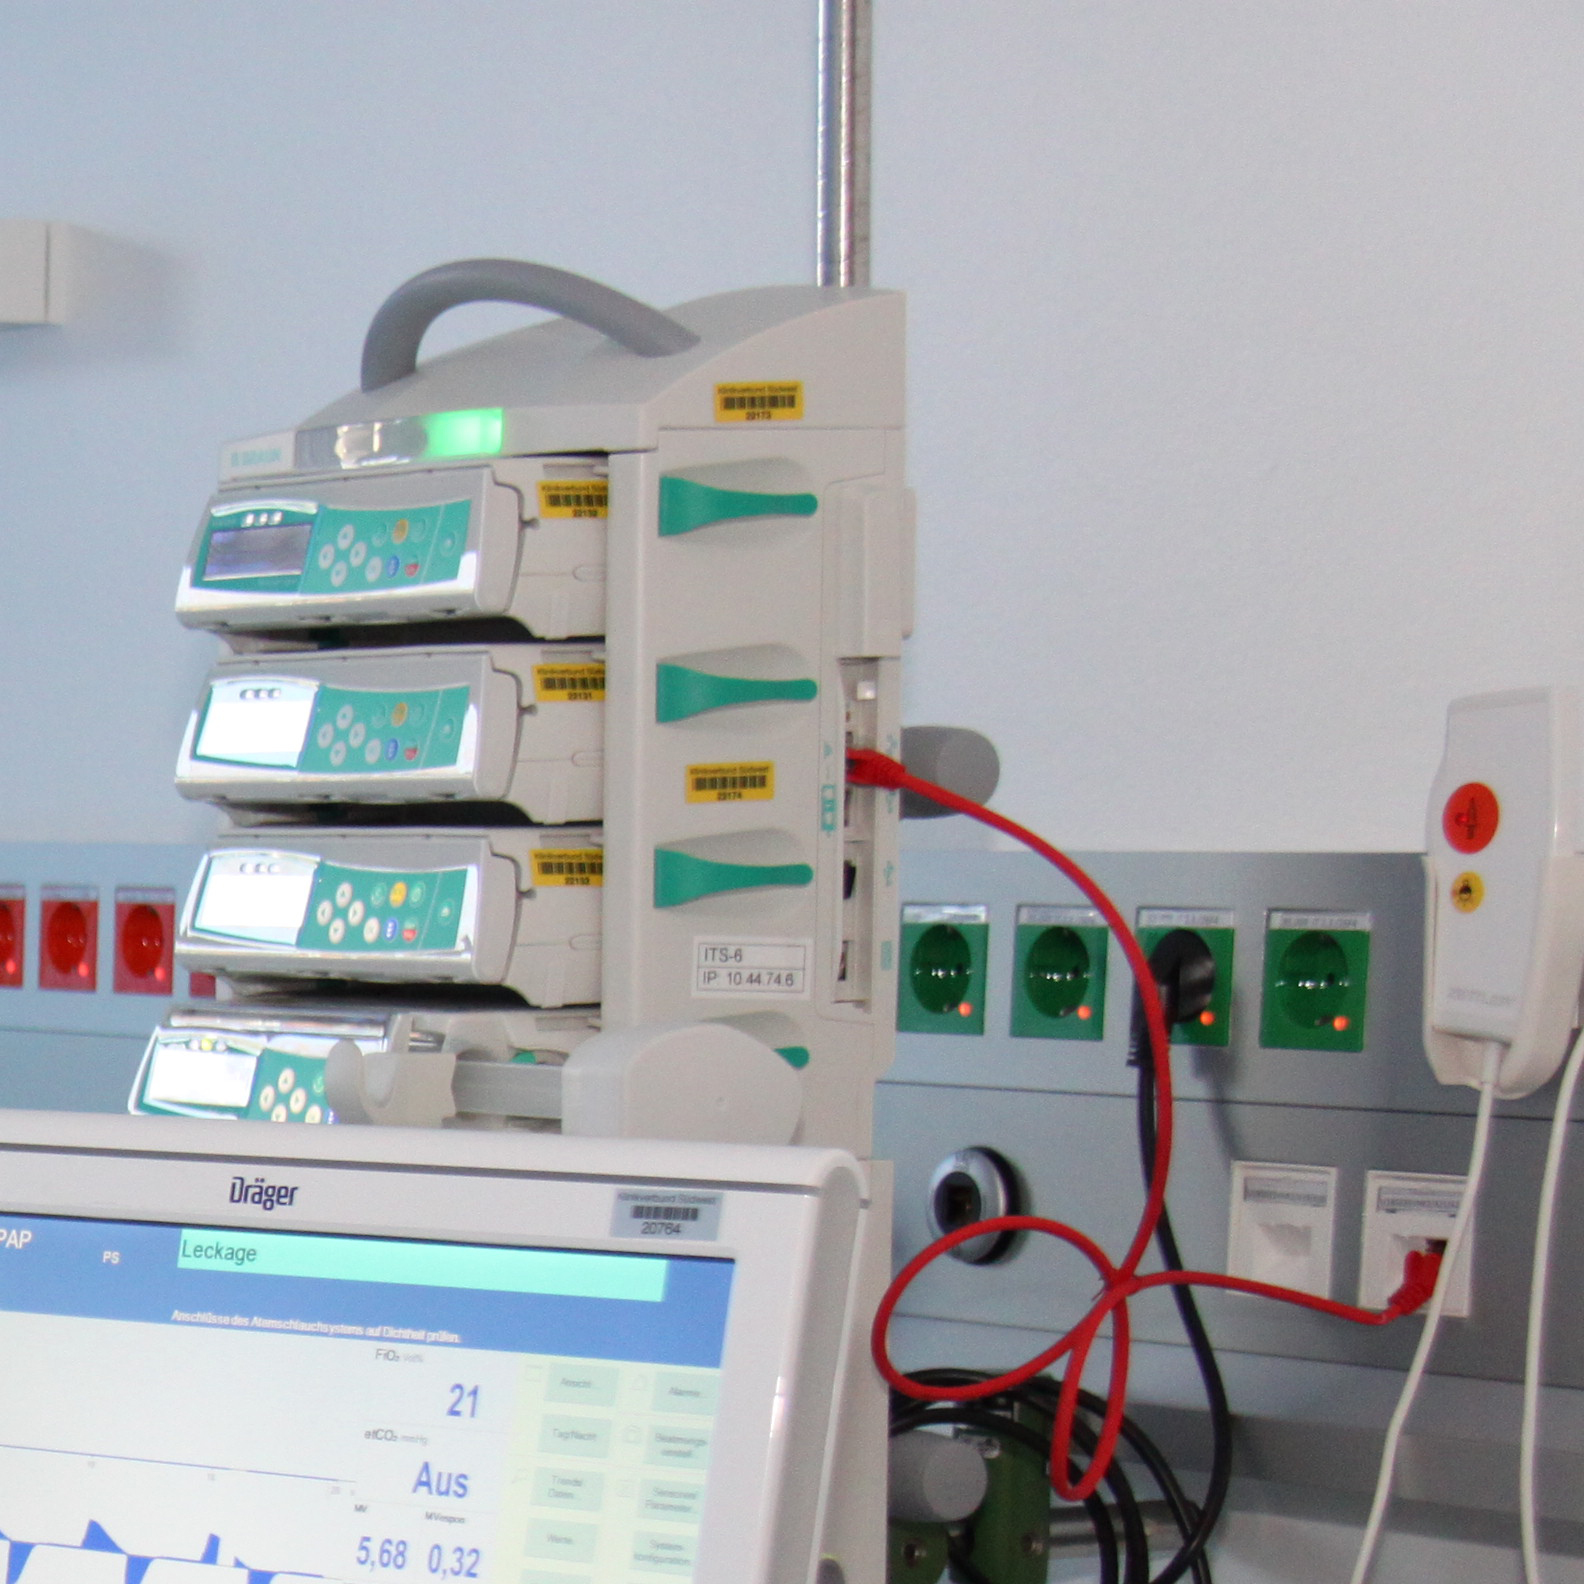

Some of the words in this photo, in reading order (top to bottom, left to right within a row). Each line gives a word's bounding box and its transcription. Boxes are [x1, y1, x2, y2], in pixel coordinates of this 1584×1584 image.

[704, 947, 743, 963] ITS-6
[229, 1177, 299, 1211] Dräger
[103, 1251, 121, 1264] PS
[182, 1239, 257, 1265] Leckage
[446, 1382, 480, 1419] 21
[411, 1460, 470, 1500] Aus
[356, 1536, 408, 1572] 5,68
[428, 1544, 480, 1580] 0,32
